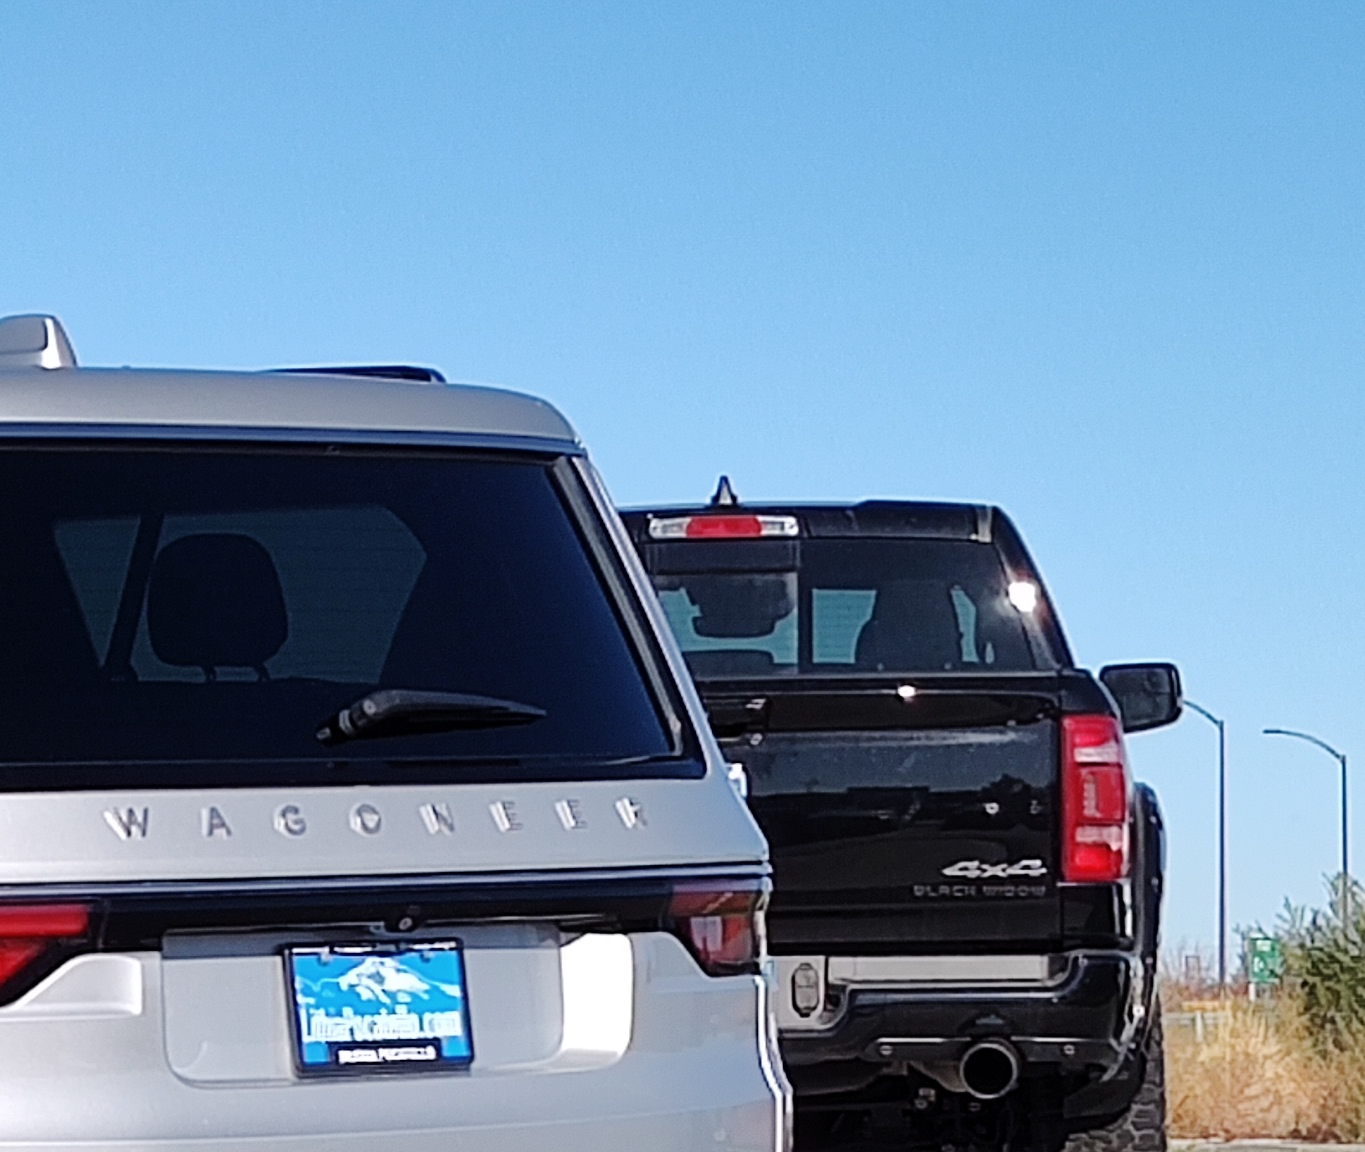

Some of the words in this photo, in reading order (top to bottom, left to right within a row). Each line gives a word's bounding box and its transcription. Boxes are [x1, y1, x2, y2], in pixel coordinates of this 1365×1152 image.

[104, 797, 648, 840] WAGONEER
[913, 885, 976, 897] BLACK
[982, 885, 1046, 897] WIDOW
